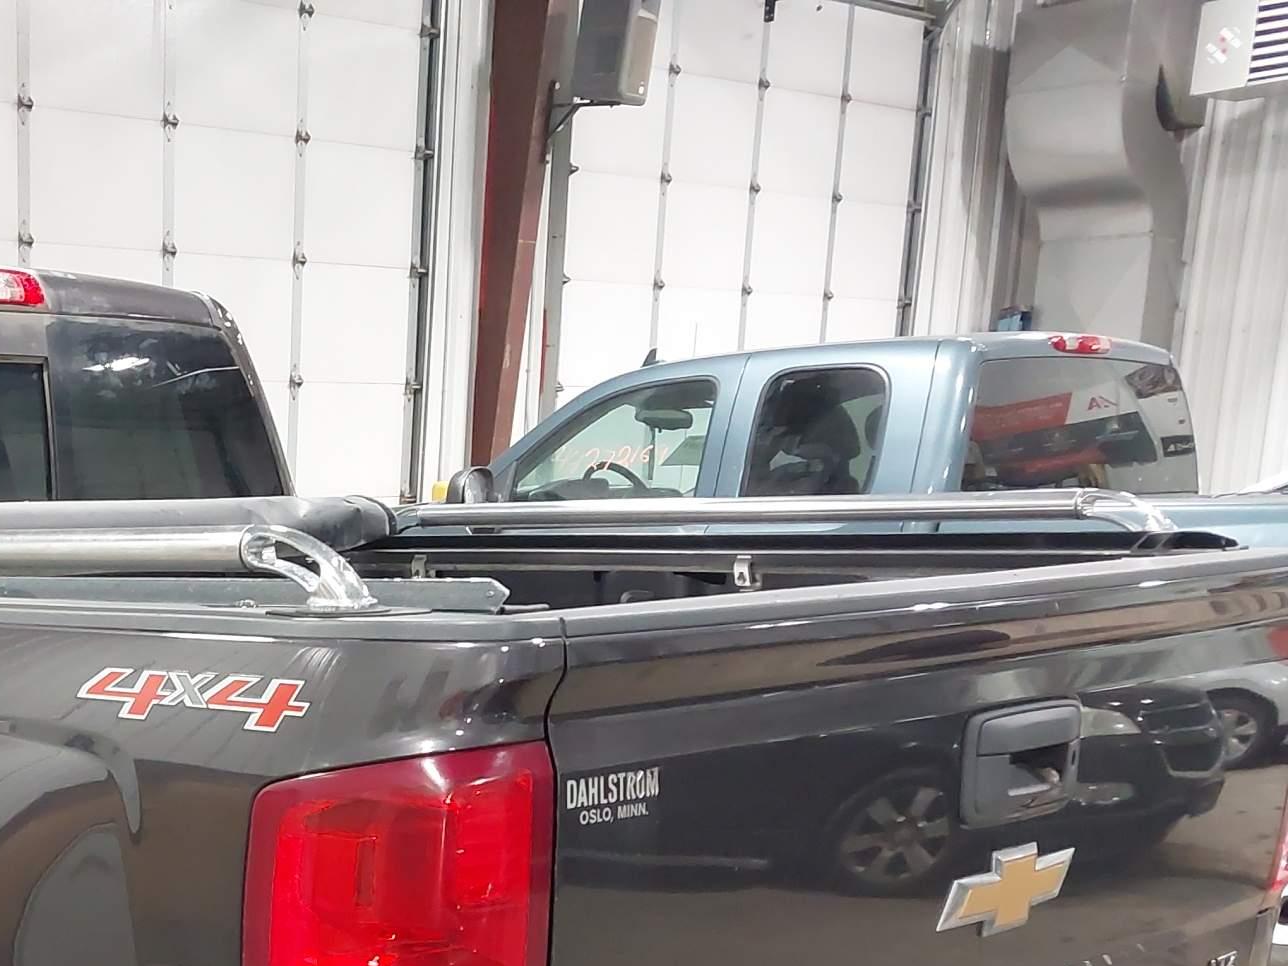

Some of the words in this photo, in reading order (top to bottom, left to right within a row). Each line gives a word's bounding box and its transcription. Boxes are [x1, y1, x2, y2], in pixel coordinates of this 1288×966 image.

[566, 766, 660, 810] DAHLSTROM
[579, 806, 615, 825] OSLO,
[617, 802, 649, 819] MINN.
